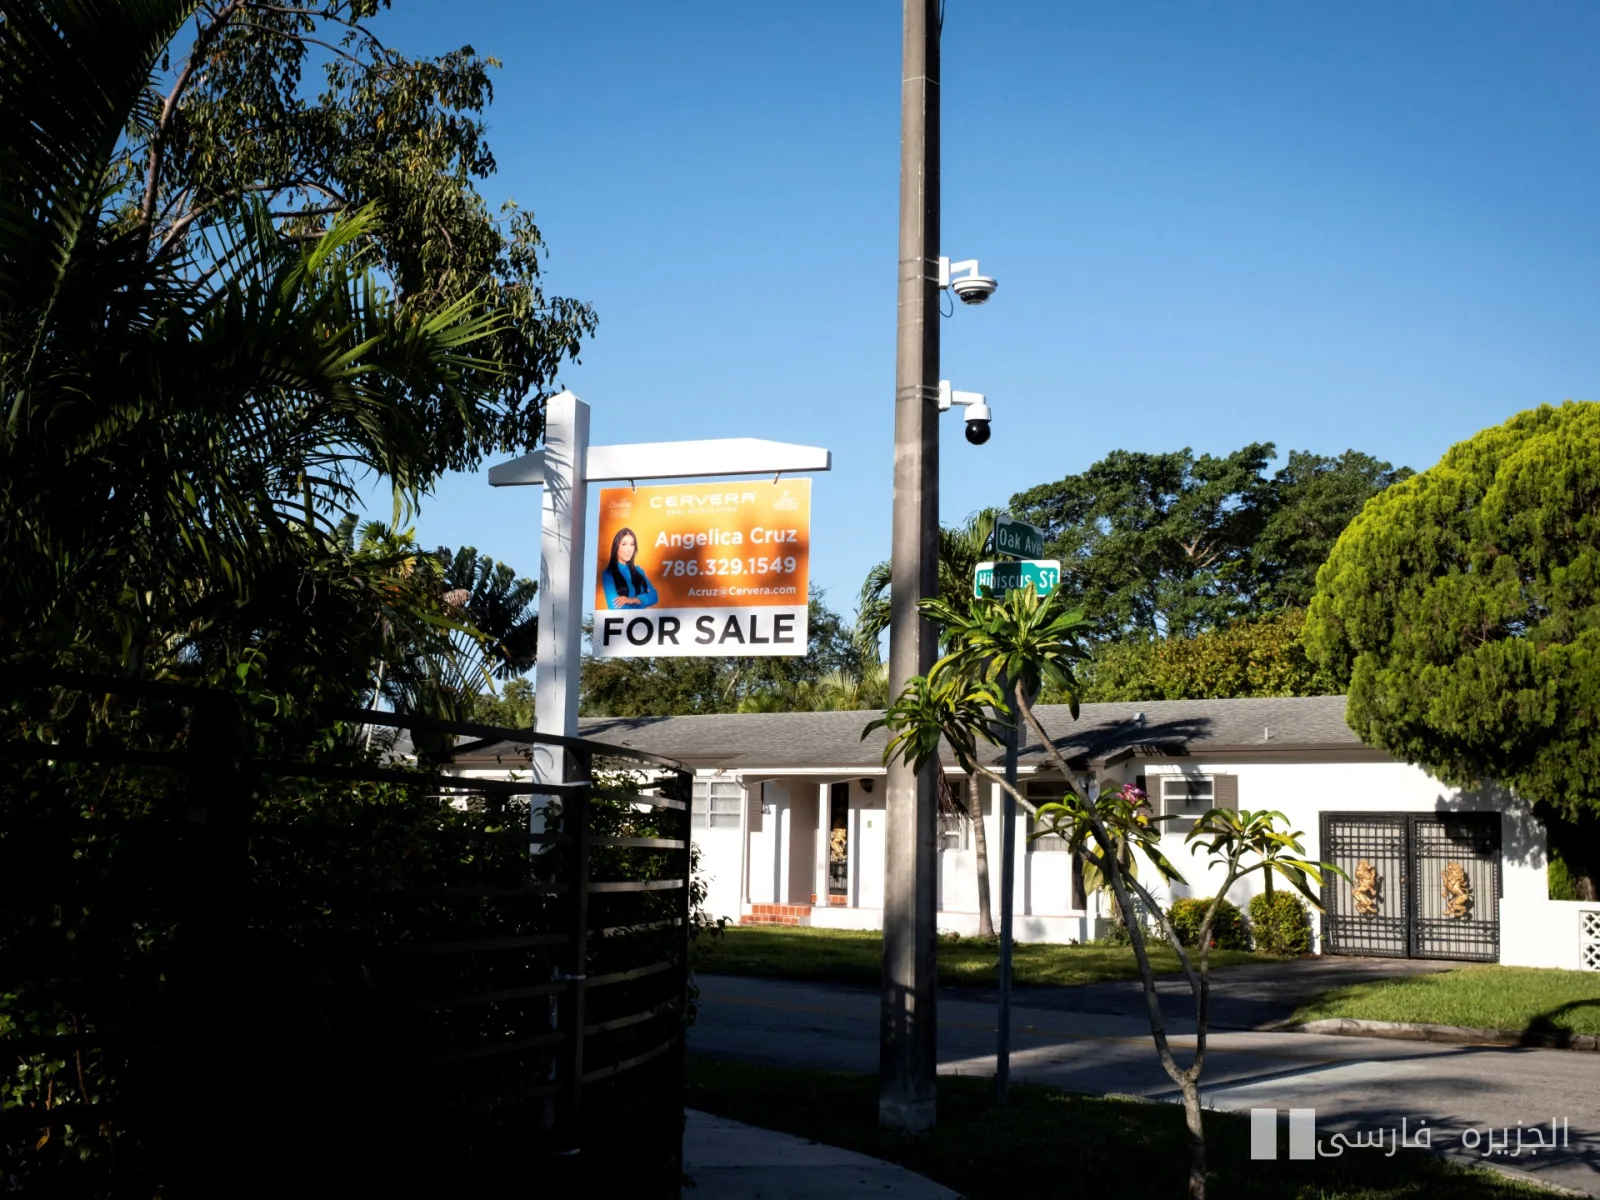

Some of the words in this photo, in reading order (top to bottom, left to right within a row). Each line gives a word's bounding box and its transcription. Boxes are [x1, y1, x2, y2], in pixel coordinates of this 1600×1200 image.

[649, 491, 756, 509] CERVERA
[654, 528, 743, 550] Angelica
[749, 527, 797, 544] Cruz
[999, 528, 1020, 550] Oak
[1024, 536, 1042, 555] Ave
[662, 556, 796, 577] 786.329.1549
[979, 572, 1032, 589] Hibiscus
[1039, 570, 1055, 589] St
[687, 585, 796, 598] Acruz@Cervera.com
[603, 616, 680, 646] FOR
[694, 614, 795, 645] SALE
